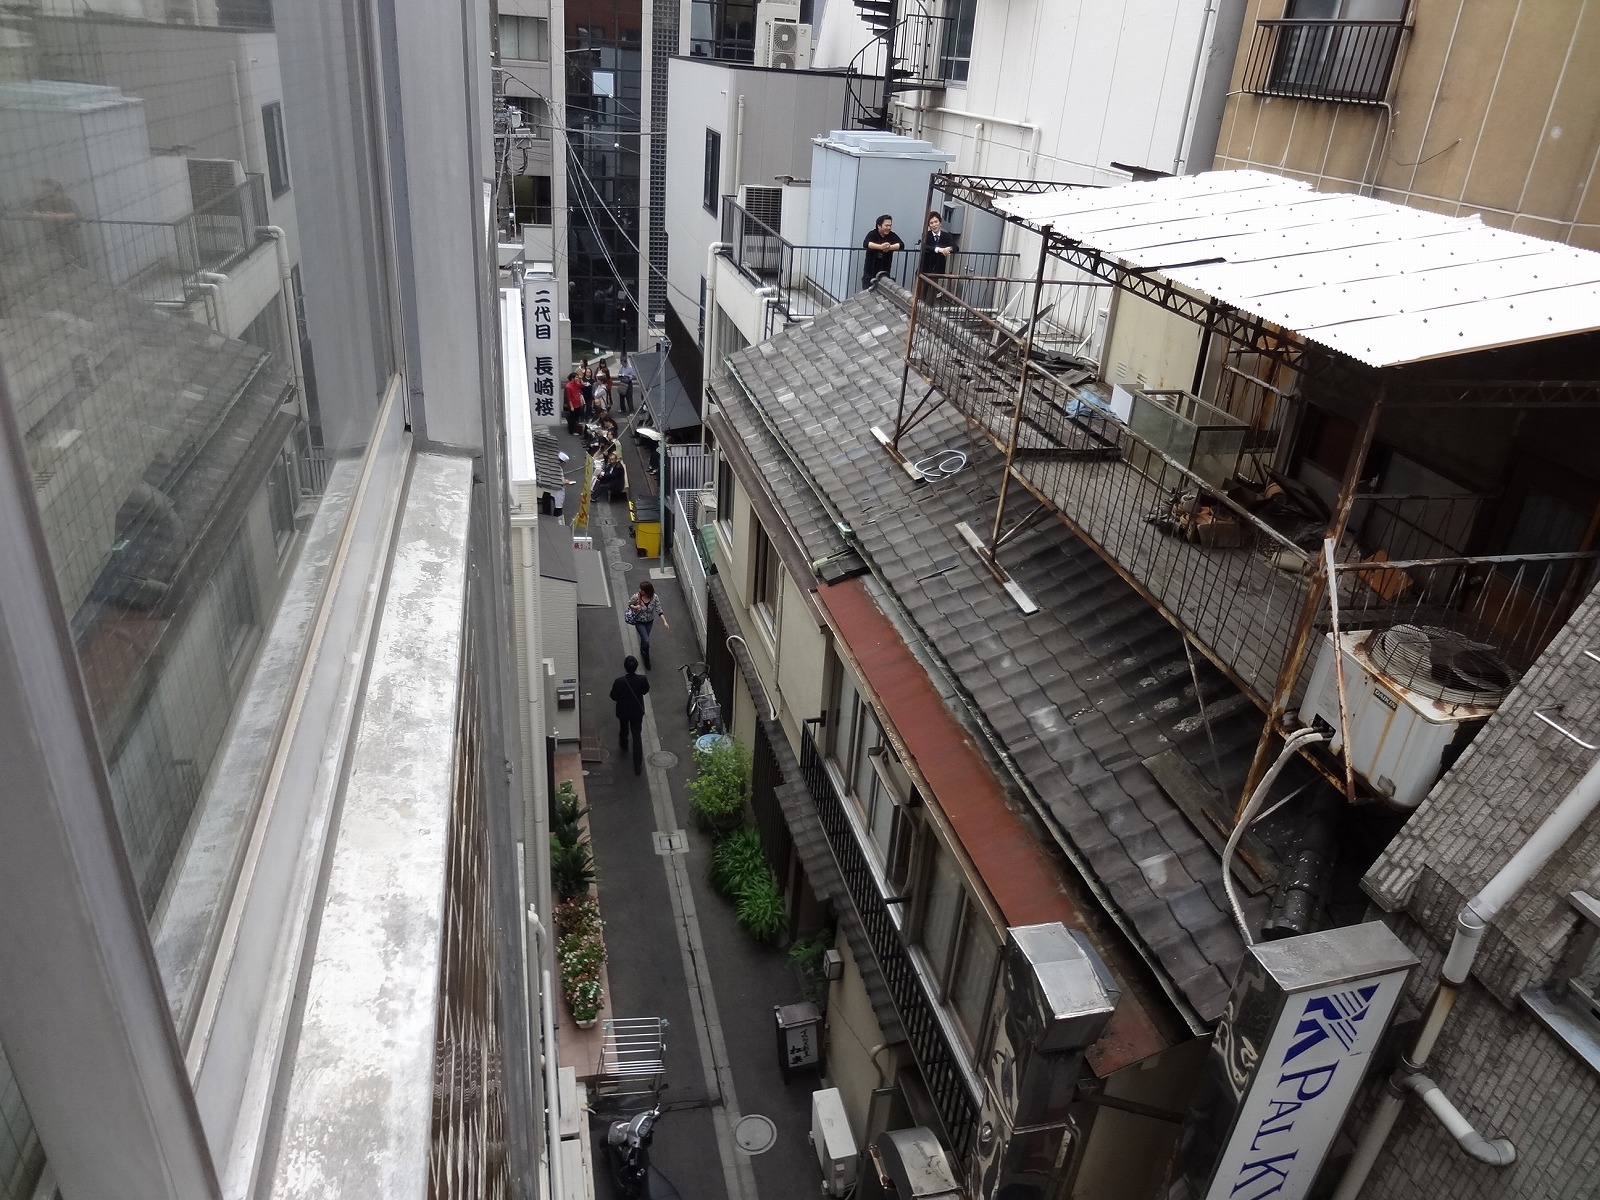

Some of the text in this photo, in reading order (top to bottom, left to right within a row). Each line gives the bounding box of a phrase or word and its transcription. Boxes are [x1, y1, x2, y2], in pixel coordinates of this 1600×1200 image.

[534, 289, 555, 417] 二代目 長崎楼
[1374, 689, 1398, 710] DAIKIN
